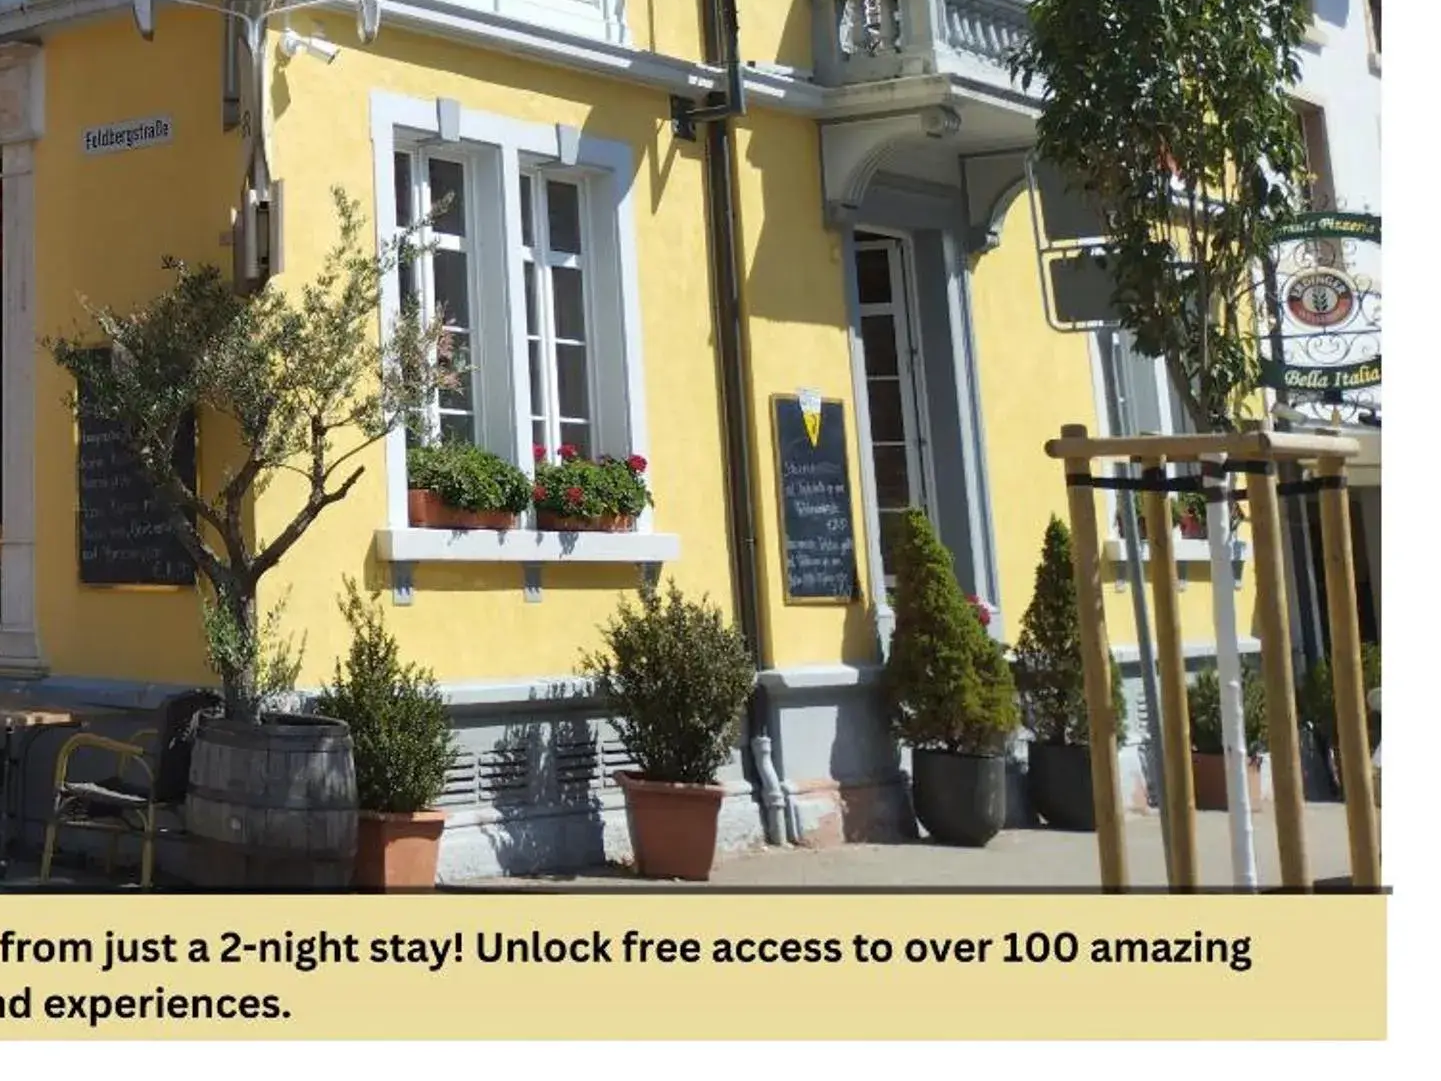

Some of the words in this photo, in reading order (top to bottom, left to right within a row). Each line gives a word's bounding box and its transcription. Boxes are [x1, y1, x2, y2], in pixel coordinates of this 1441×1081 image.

[86, 119, 169, 151] Feldbergstraße
[1284, 368, 1328, 388] Bella
[1334, 365, 1381, 387] Italia
